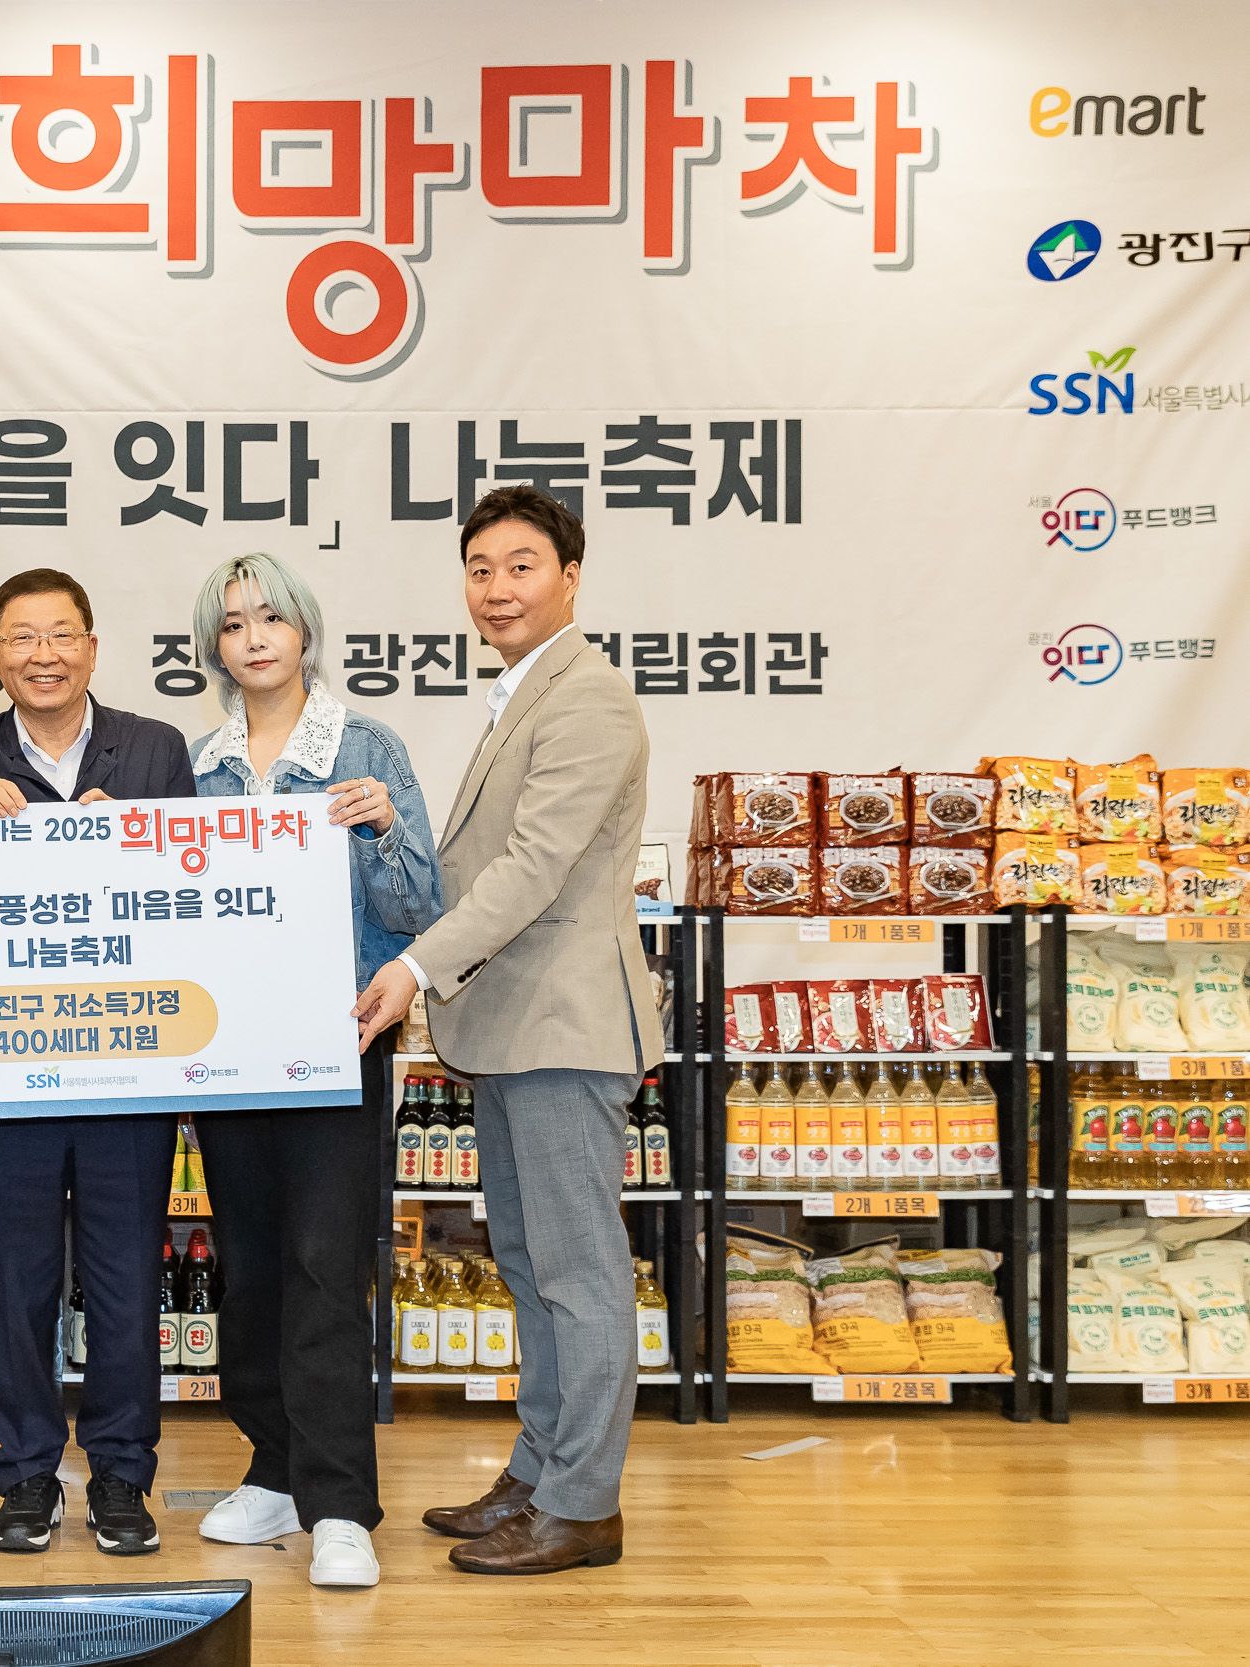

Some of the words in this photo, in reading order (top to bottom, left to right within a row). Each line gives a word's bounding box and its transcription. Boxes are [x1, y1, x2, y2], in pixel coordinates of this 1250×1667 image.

[1029, 86, 1206, 138] emart
[1118, 229, 1250, 267] 광진구
[1028, 372, 1134, 415] SSN
[1141, 382, 1250, 413] 서울특별시
[390, 415, 803, 527] 나눔축제
[1042, 510, 1106, 547] 잇다
[1121, 505, 1218, 530] 푸드뱅크
[152, 634, 208, 697] 장
[1043, 645, 1110, 682] 잇다
[1129, 639, 1216, 661] 푸드뱅크
[45, 816, 112, 843] 2025
[120, 806, 309, 876] 희망마차
[843, 924, 867, 940] 1개
[881, 923, 921, 940] 1품목
[1180, 922, 1204, 938] 1개
[7, 935, 132, 969] 나눔축제
[54, 991, 180, 1018] 저소득가정
[109, 1025, 159, 1051] 지원
[26, 1073, 60, 1089] SSN
[184, 1069, 206, 1083] 잇다
[210, 1068, 239, 1077] 푸드뱅크
[286, 1066, 307, 1080] 잇다
[312, 1065, 341, 1074] 푸드뱅크
[1181, 1060, 1207, 1076] 3개
[173, 1197, 198, 1214] 3개
[846, 1197, 871, 1214] 2개
[885, 1197, 925, 1214] 1품목
[191, 1380, 216, 1398] 2개
[856, 1381, 880, 1398] 1개
[893, 1382, 936, 1399] 2품목
[1186, 1383, 1212, 1399] 3개
